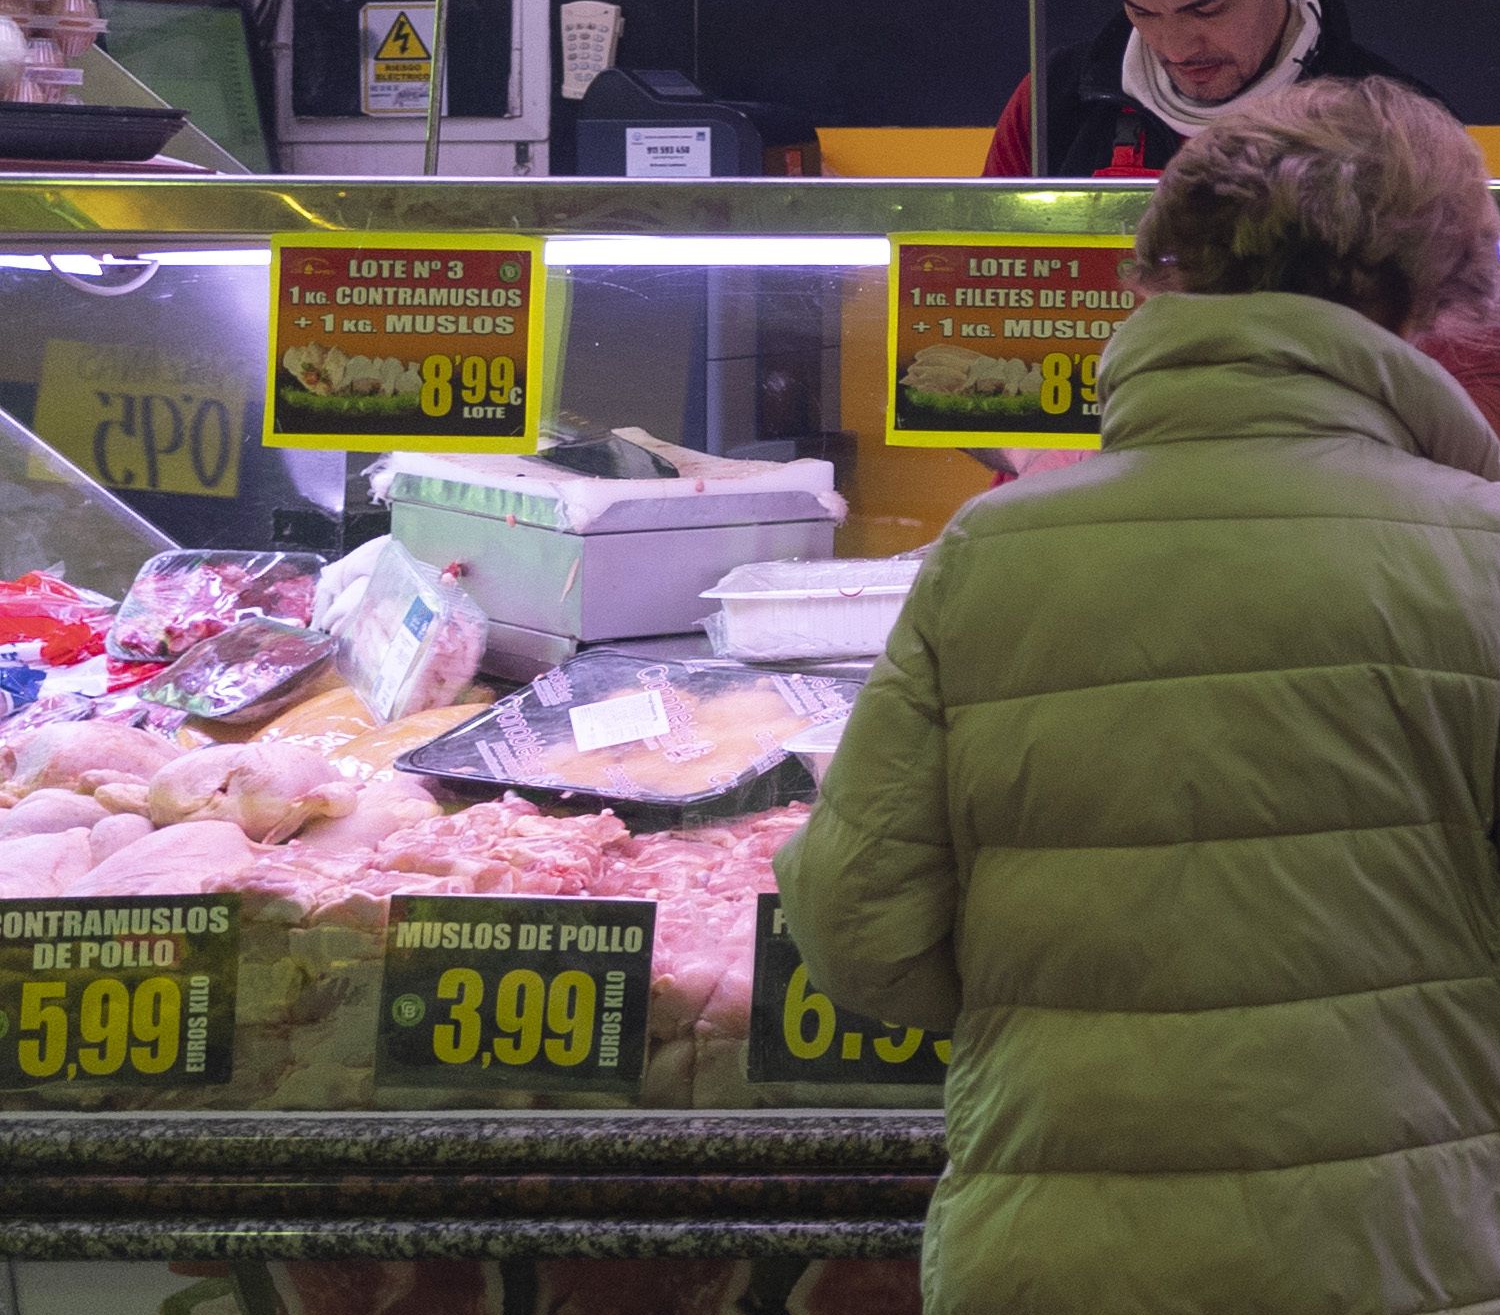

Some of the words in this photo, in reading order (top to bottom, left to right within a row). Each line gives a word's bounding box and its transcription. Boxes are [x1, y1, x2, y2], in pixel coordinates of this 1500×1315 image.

[396, 922, 512, 950] MUSLOS
[518, 925, 553, 951] DE
[559, 925, 643, 953] POLLO
[604, 970, 626, 1008] KILO
[433, 967, 597, 1069] 3,99
[599, 1011, 622, 1067] EUROS
